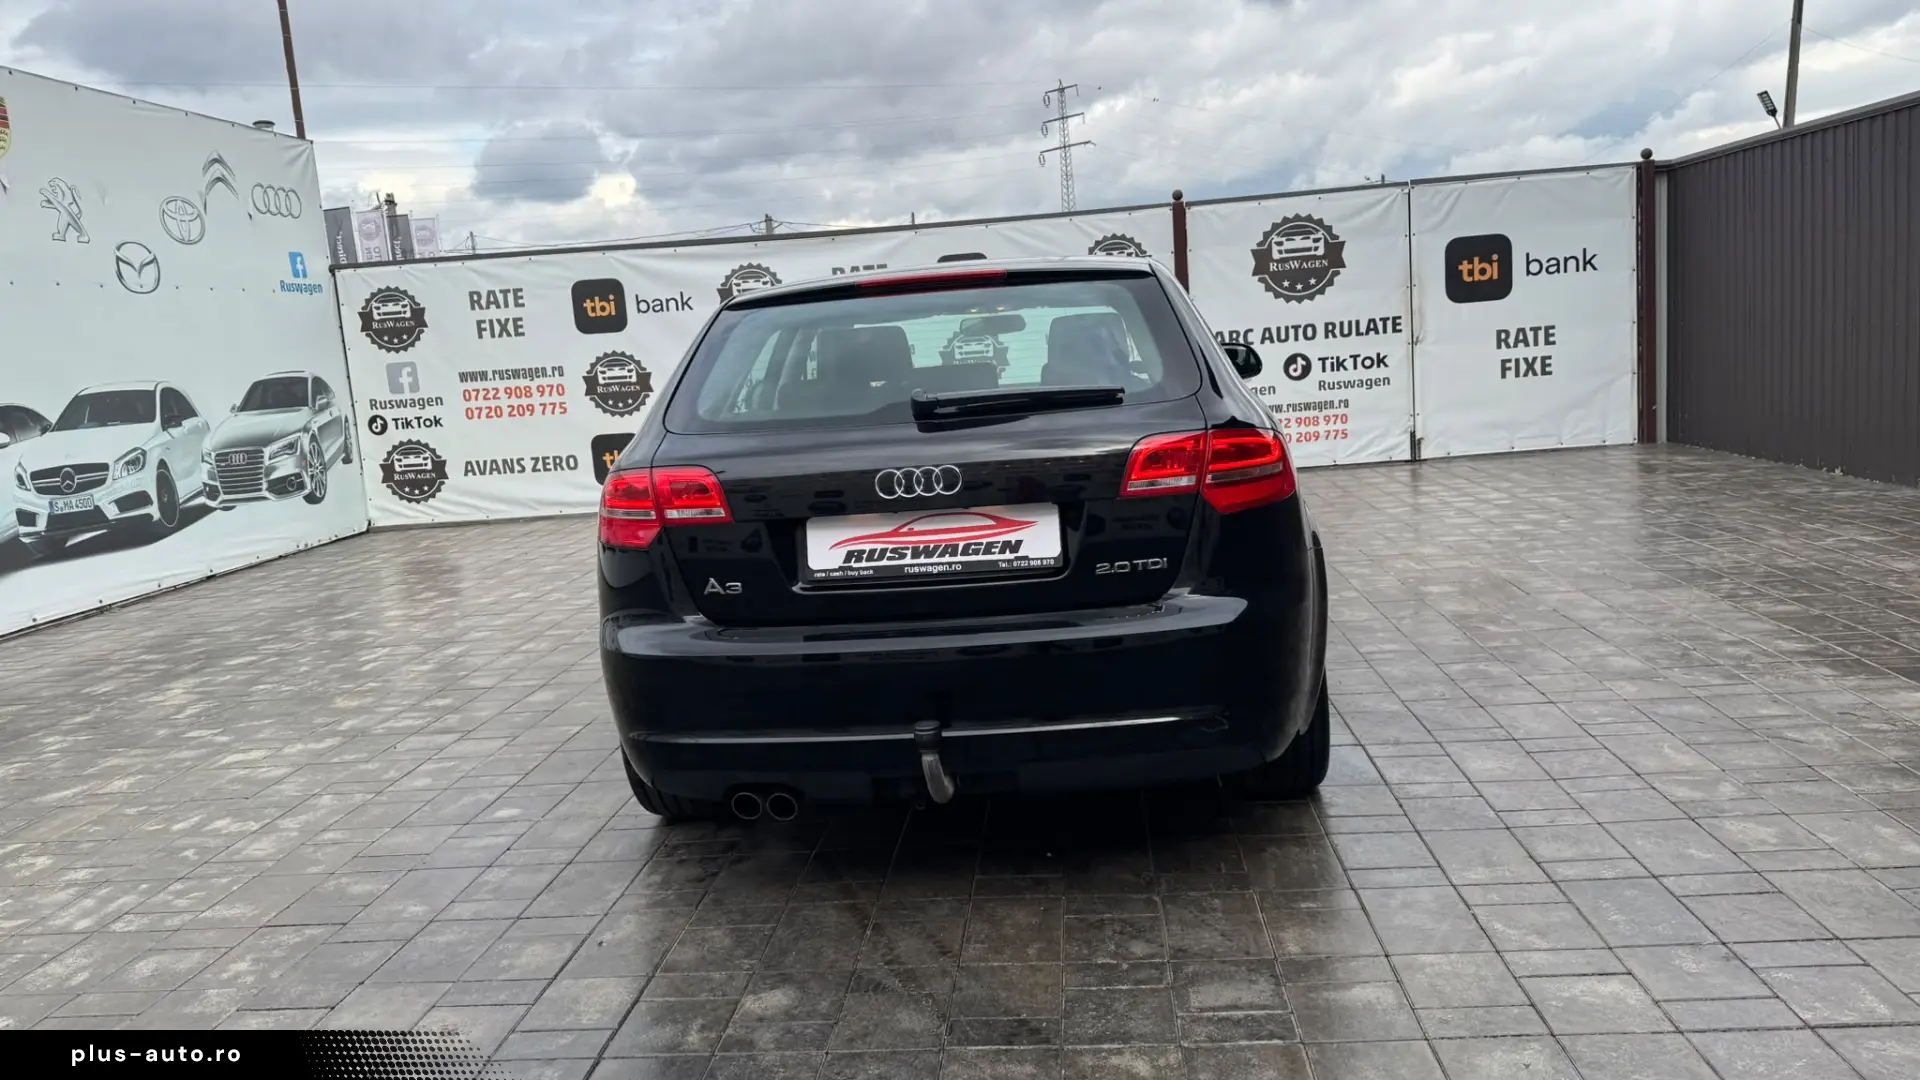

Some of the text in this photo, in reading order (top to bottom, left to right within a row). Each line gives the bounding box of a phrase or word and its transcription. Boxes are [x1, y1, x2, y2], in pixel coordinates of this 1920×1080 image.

[1458, 248, 1599, 282] tbi bank
[280, 280, 323, 296] Ruswagen
[468, 288, 525, 311] RATE
[583, 291, 694, 317] tbi bank
[476, 316, 525, 340] FIXE
[1214, 315, 1403, 346] ARC AUTO RULATE
[1496, 325, 1557, 350] RATE
[1318, 352, 1389, 373] TikTok
[1500, 354, 1553, 379] FIXE
[458, 366, 565, 383] www.ruswagen.ro
[462, 383, 566, 402] 0722 908 970
[1318, 376, 1391, 392] Ruswagen
[369, 396, 444, 411] Ruswagen
[465, 402, 568, 420] 0720 209 775
[1268, 399, 1349, 414] ww.ruswagen.ro
[392, 415, 444, 430] TikTok
[1295, 416, 1320, 428] 908
[1323, 414, 1348, 426] 970
[1296, 431, 1320, 443] 209
[1324, 429, 1348, 440] 775
[463, 457, 526, 477] AVANS
[531, 454, 579, 474] ZERO
[842, 540, 1024, 564] RUSWAGEN
[904, 563, 962, 575] ruswagen.ro
[1042, 558, 1054, 566] 970
[1095, 558, 1168, 575] 2.0 TDI
[704, 577, 742, 595] A3
